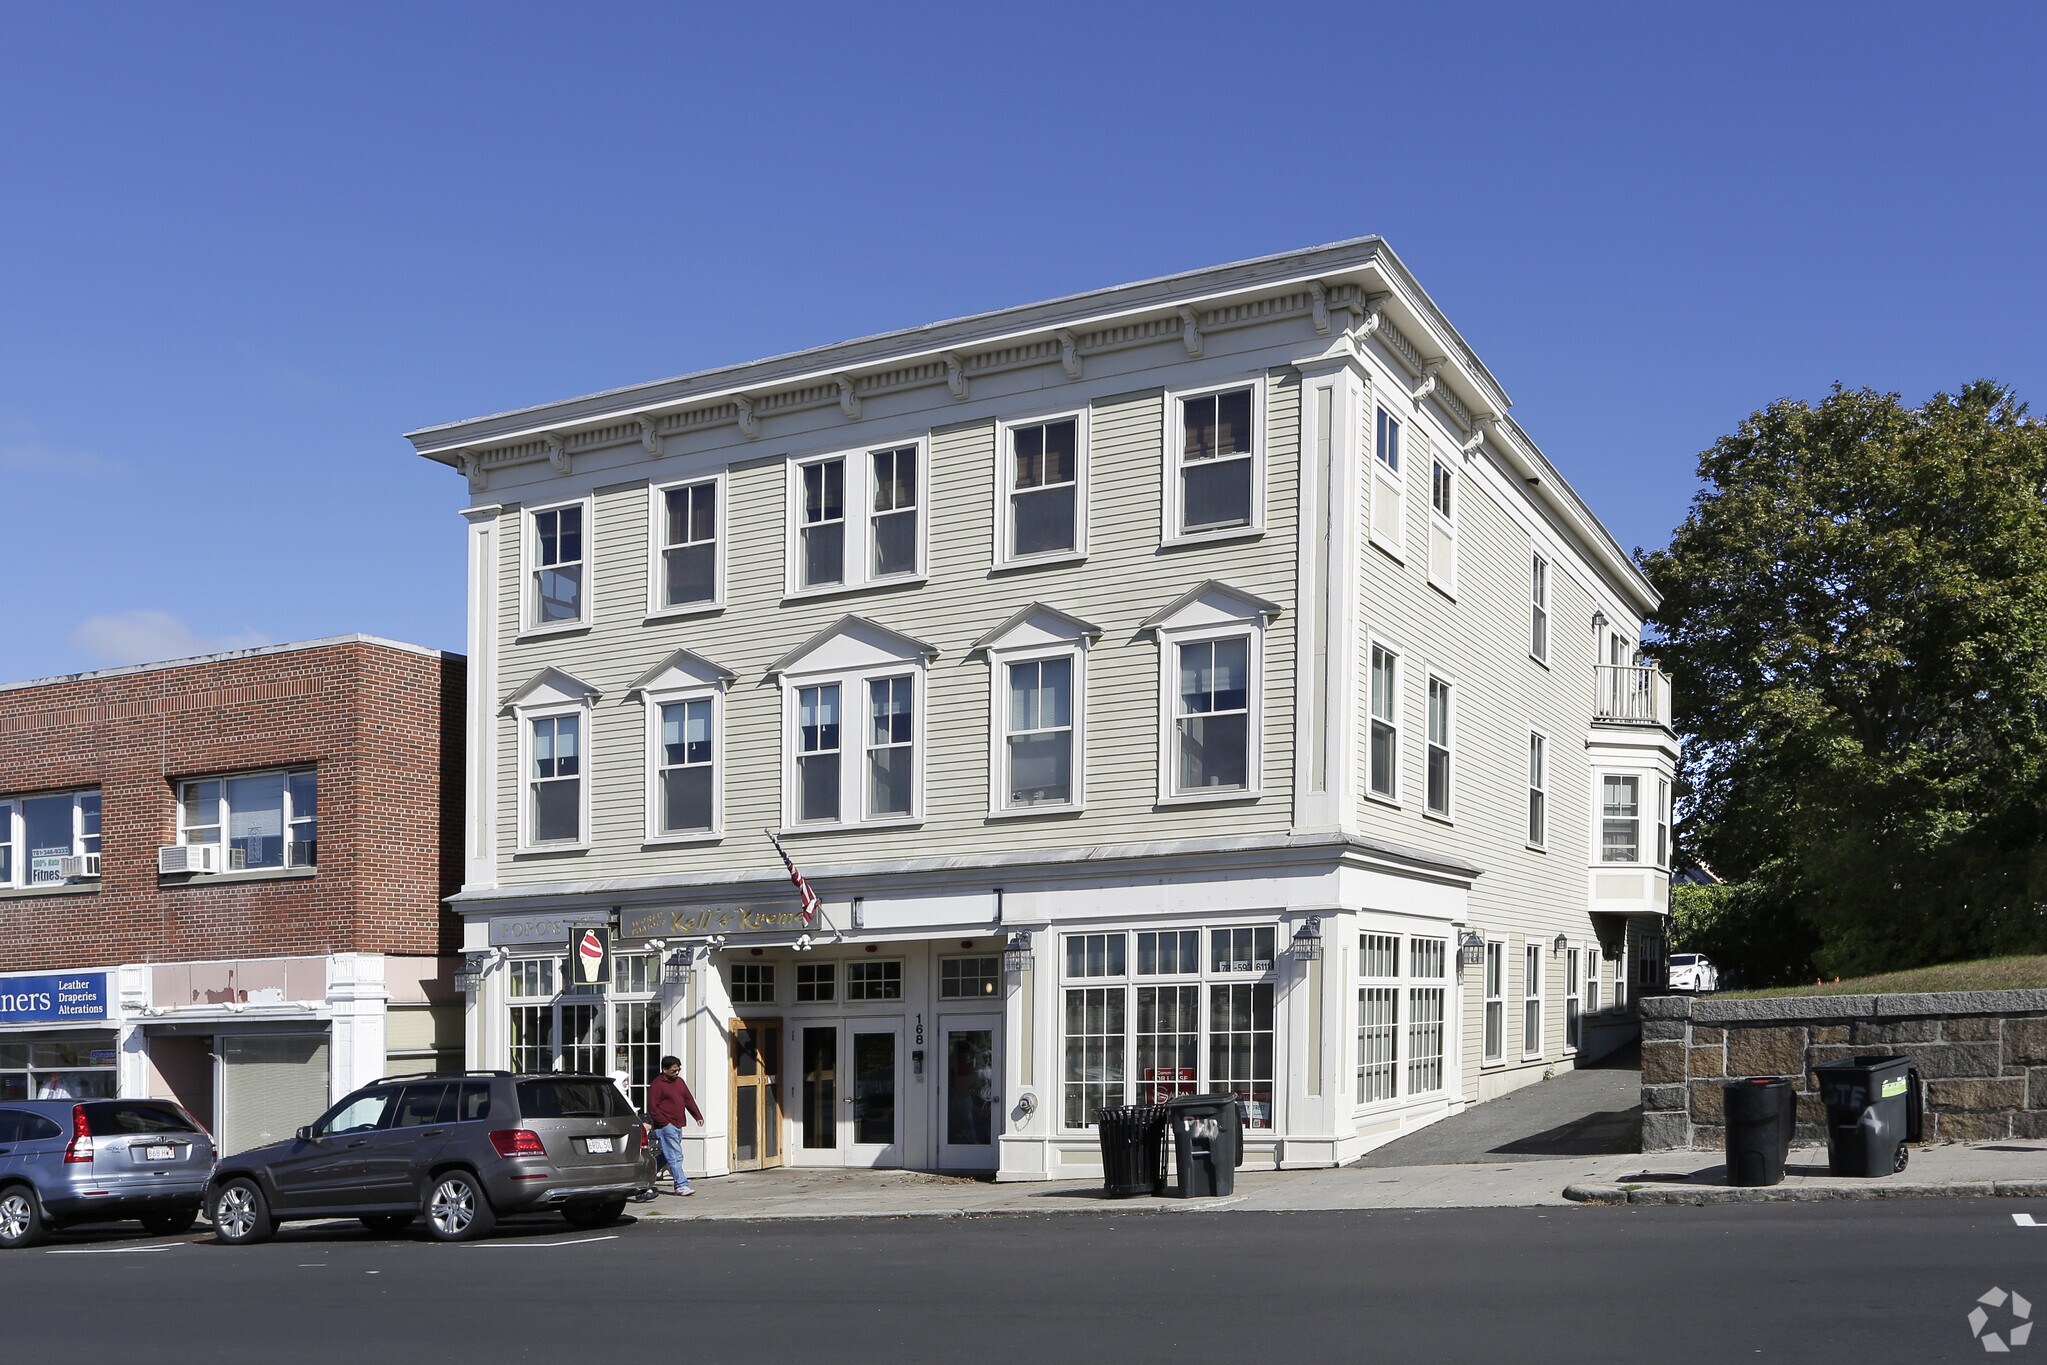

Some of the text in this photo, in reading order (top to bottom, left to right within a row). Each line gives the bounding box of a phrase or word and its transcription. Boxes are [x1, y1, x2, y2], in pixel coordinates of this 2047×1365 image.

[33, 869, 65, 881] Fitnes
[501, 920, 561, 938] POPO'S
[58, 980, 90, 990] Leather
[58, 992, 97, 1004] Draperies
[58, 1004, 104, 1014] Alterations
[915, 1013, 924, 1045] 168
